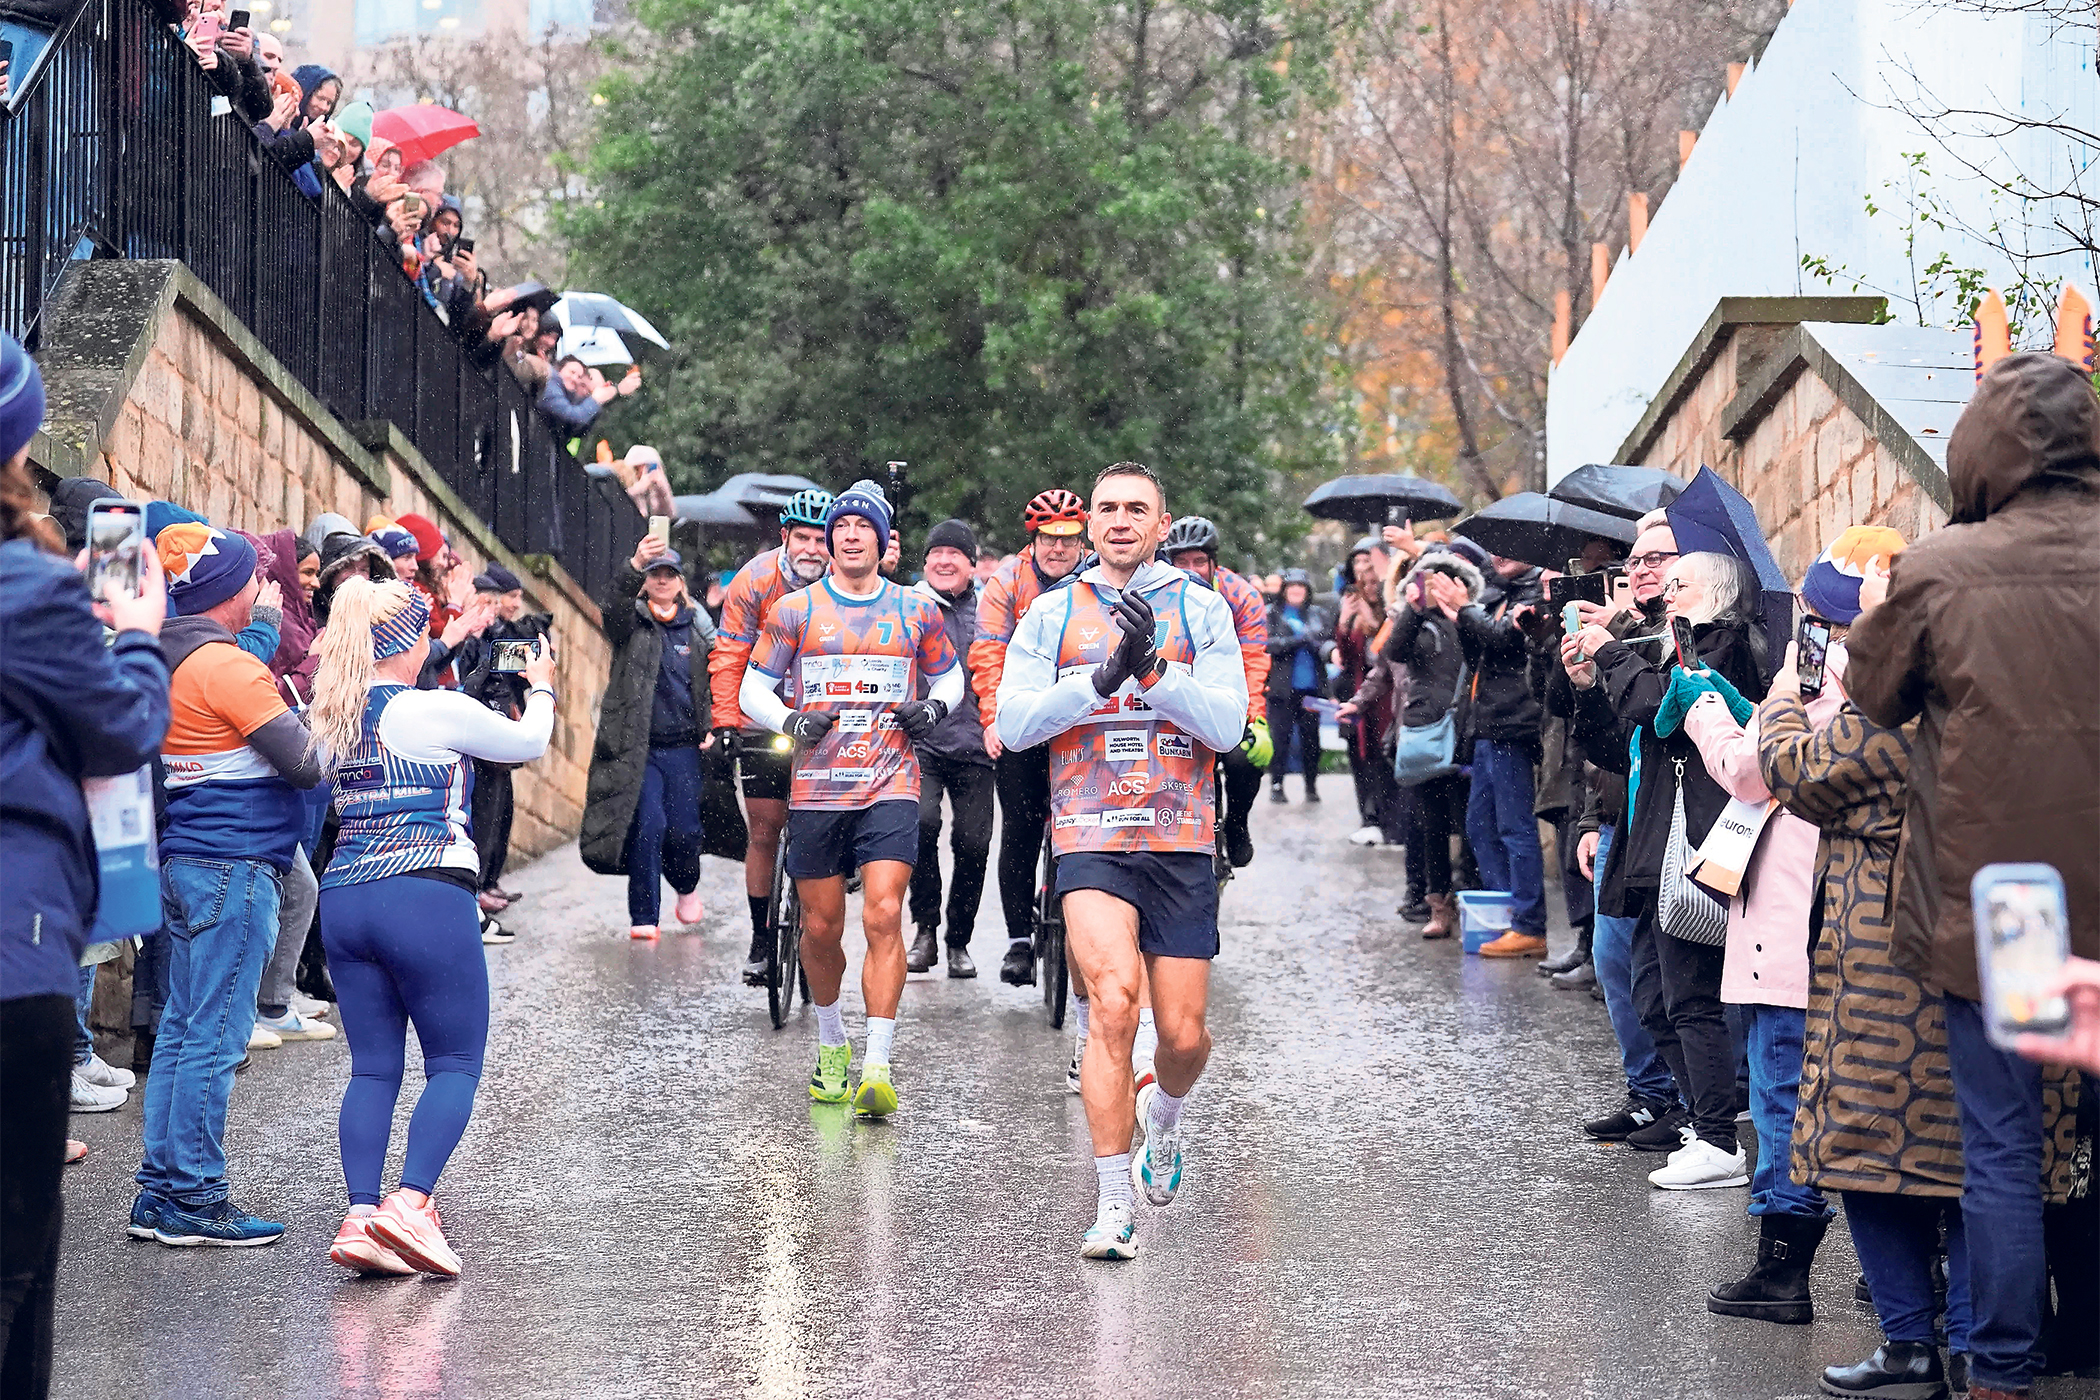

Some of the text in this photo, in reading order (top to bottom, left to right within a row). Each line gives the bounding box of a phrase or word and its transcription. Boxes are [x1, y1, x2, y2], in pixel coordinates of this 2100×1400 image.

[876, 620, 894, 645] 7
[855, 680, 878, 694] 4ED
[836, 746, 867, 758] ACS
[1159, 745, 1192, 758] BUNKABIN
[393, 787, 432, 798] MILE
[1058, 786, 1098, 797] ROMERO
[1108, 780, 1145, 797] ACS
[1161, 781, 1194, 792] SKOPES
